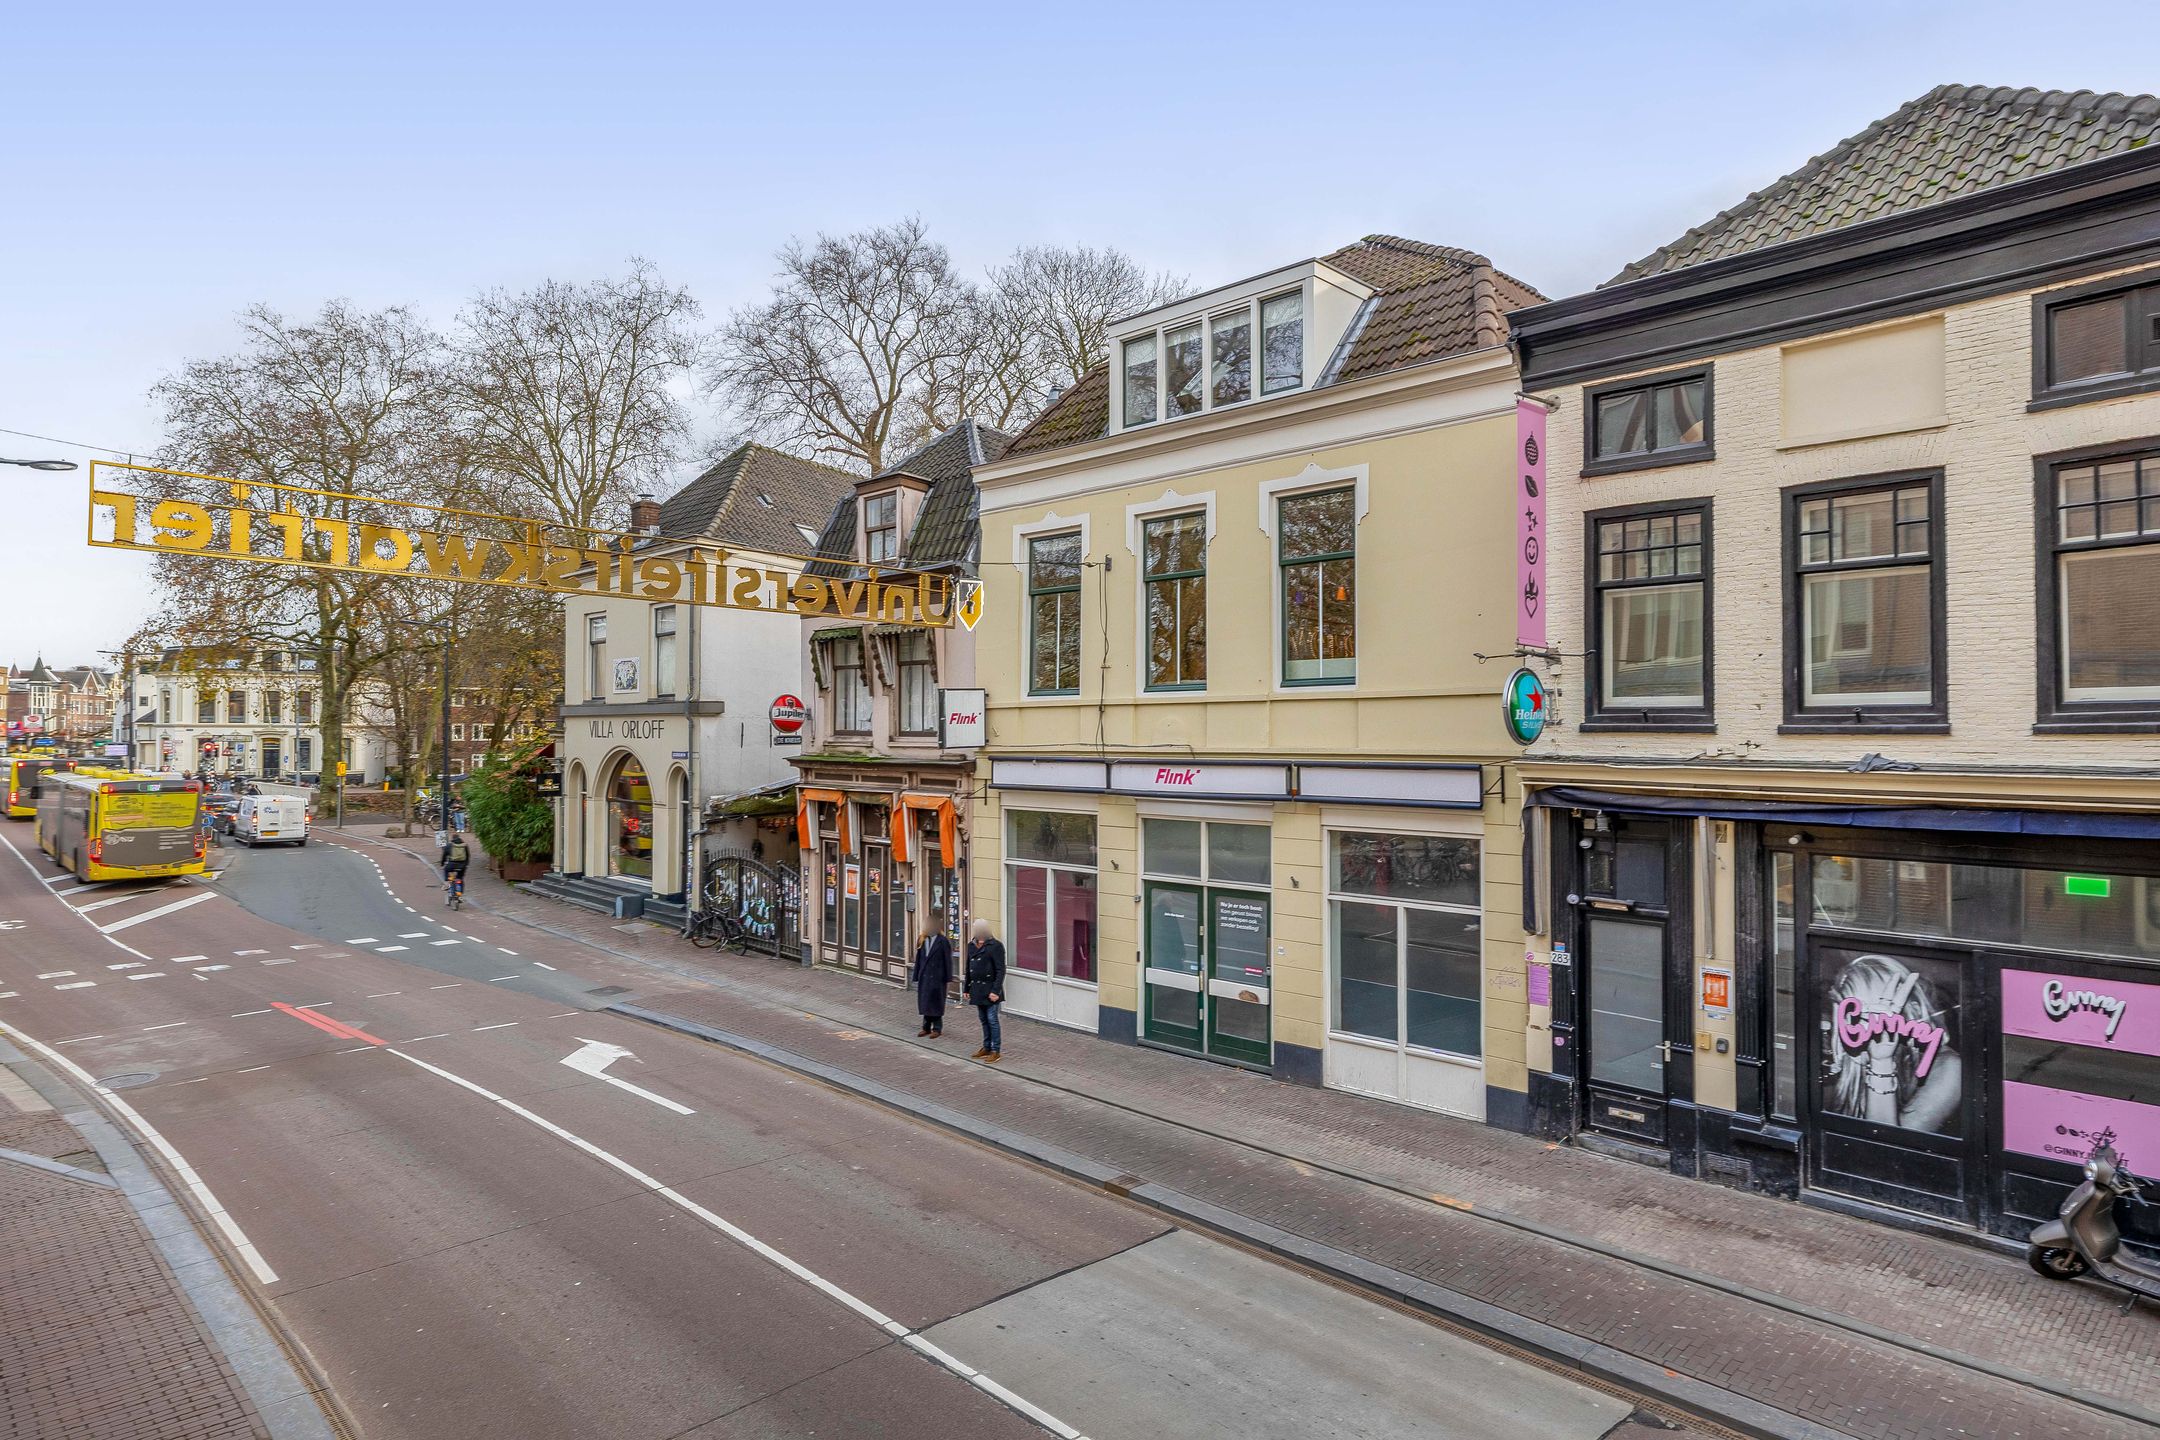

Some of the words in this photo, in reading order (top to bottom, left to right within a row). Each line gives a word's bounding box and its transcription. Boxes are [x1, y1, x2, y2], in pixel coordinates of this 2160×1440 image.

[774, 708, 804, 718] Jupiler
[949, 712, 981, 725] Flink
[589, 720, 614, 738] VILLA
[621, 719, 665, 739] ORLOFF
[1154, 767, 1201, 786] Flink
[1551, 952, 1569, 963] 283
